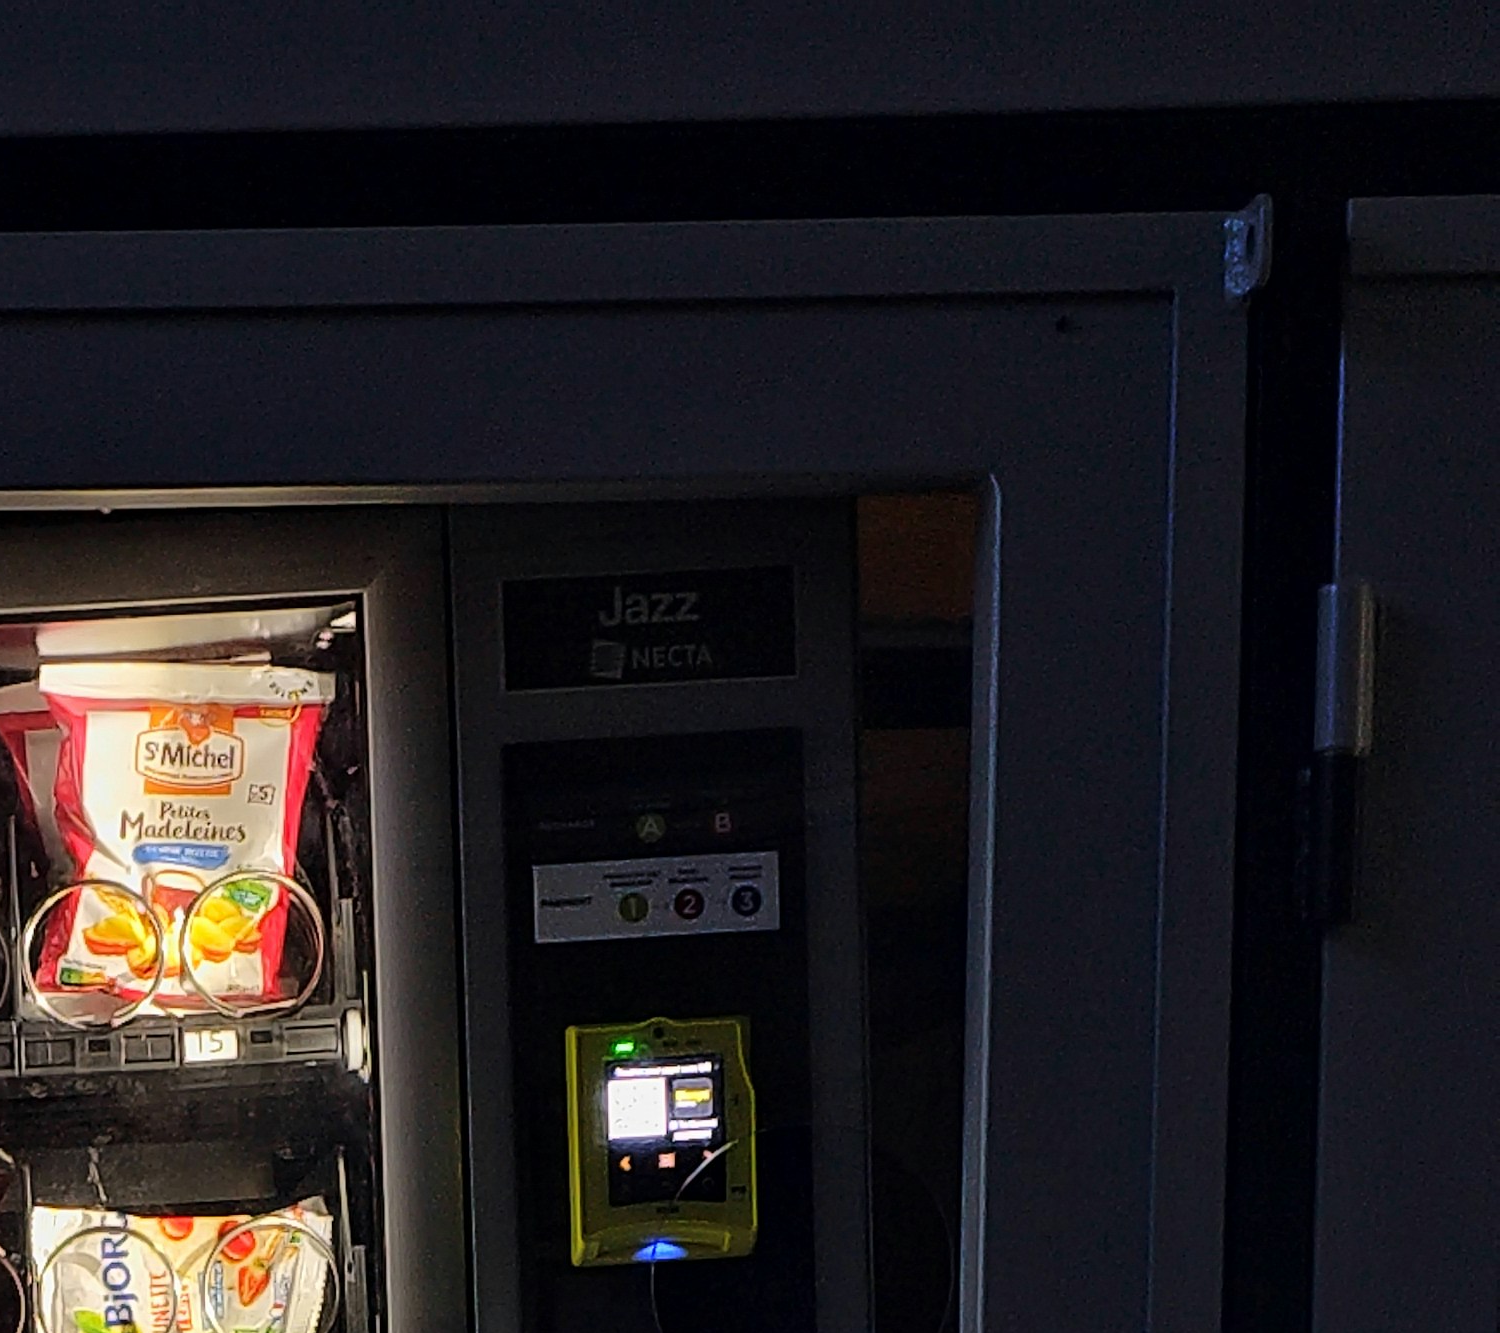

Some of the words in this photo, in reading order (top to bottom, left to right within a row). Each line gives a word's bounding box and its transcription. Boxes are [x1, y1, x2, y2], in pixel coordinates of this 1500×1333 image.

[600, 585, 701, 628] Jazz
[628, 643, 715, 671] NECTA
[160, 743, 236, 771] Michel
[119, 808, 247, 843] Madeleines
[642, 816, 663, 838] A
[714, 811, 733, 834] B
[682, 896, 698, 915] 2
[739, 891, 755, 911] 3
[198, 1032, 224, 1055] 15
